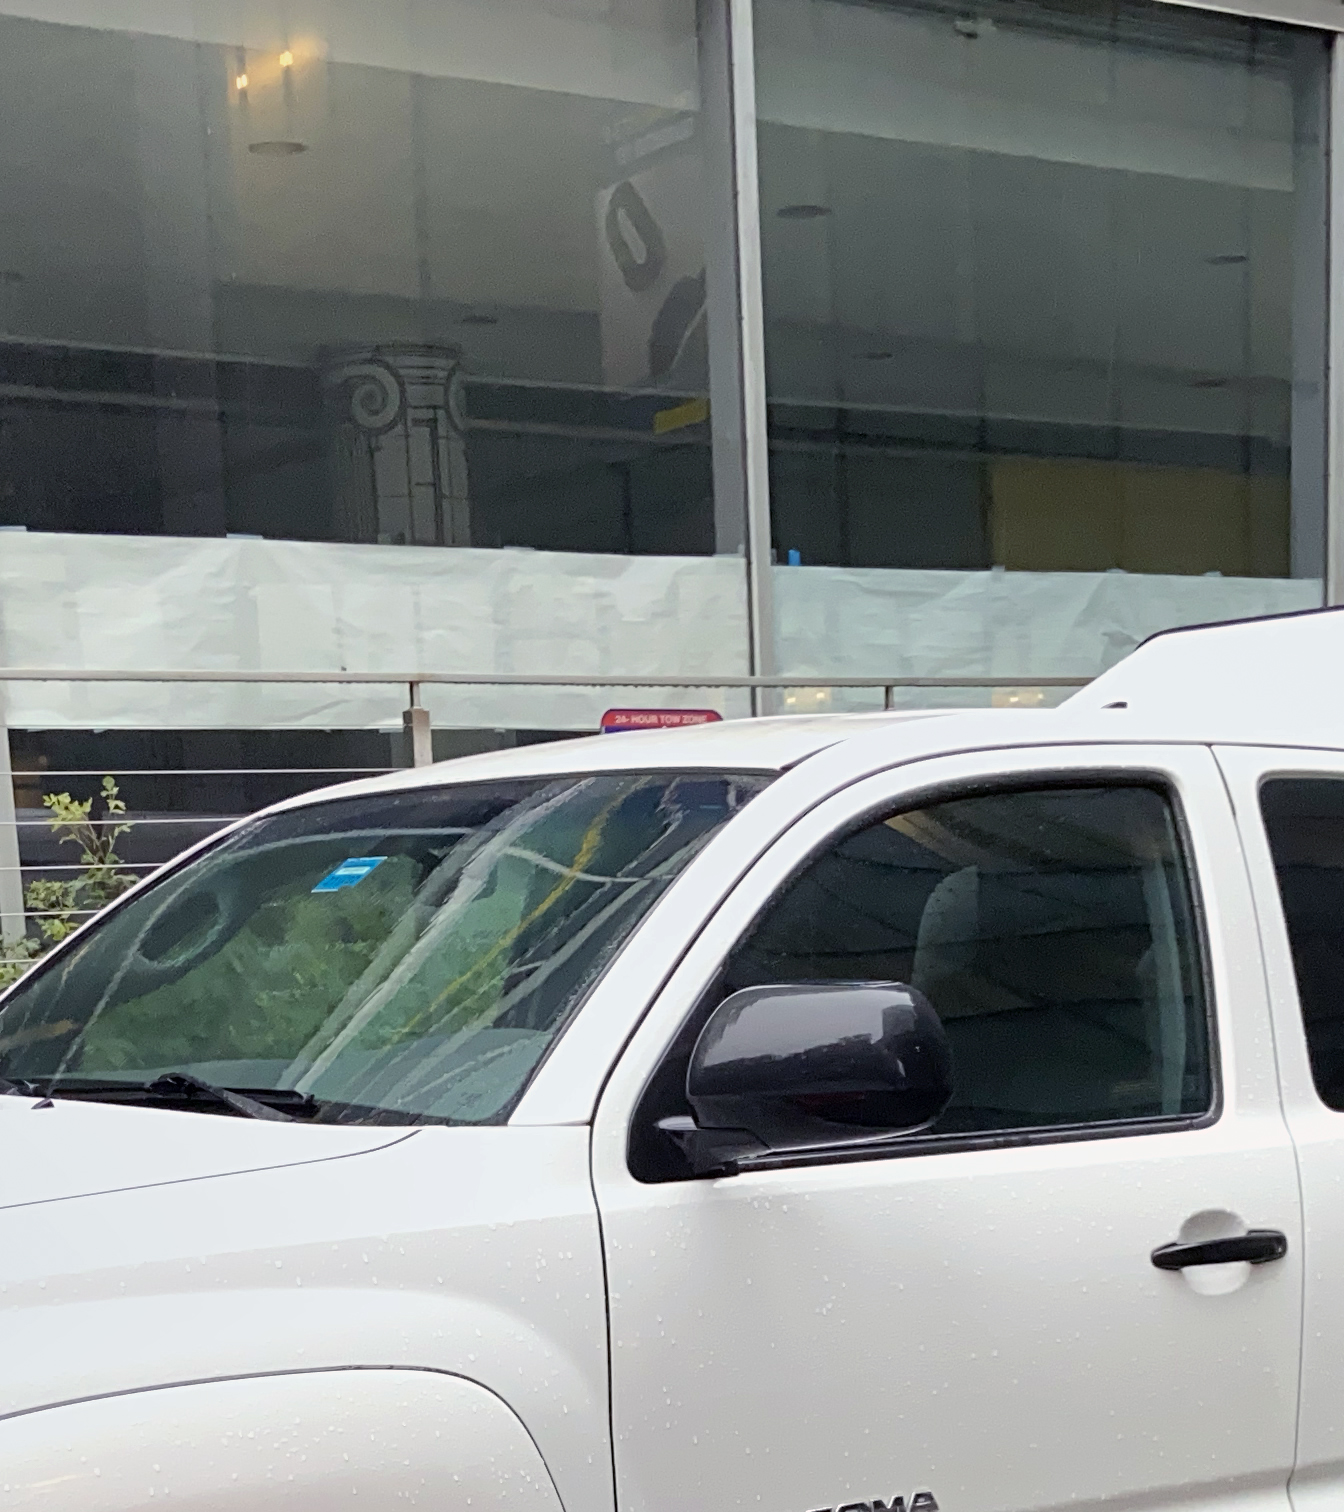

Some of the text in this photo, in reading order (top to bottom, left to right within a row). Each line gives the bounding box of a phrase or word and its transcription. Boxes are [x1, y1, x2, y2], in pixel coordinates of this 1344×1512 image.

[630, 714, 658, 724] HOUR
[659, 714, 681, 724] TOW
[682, 714, 708, 724] ZONE
